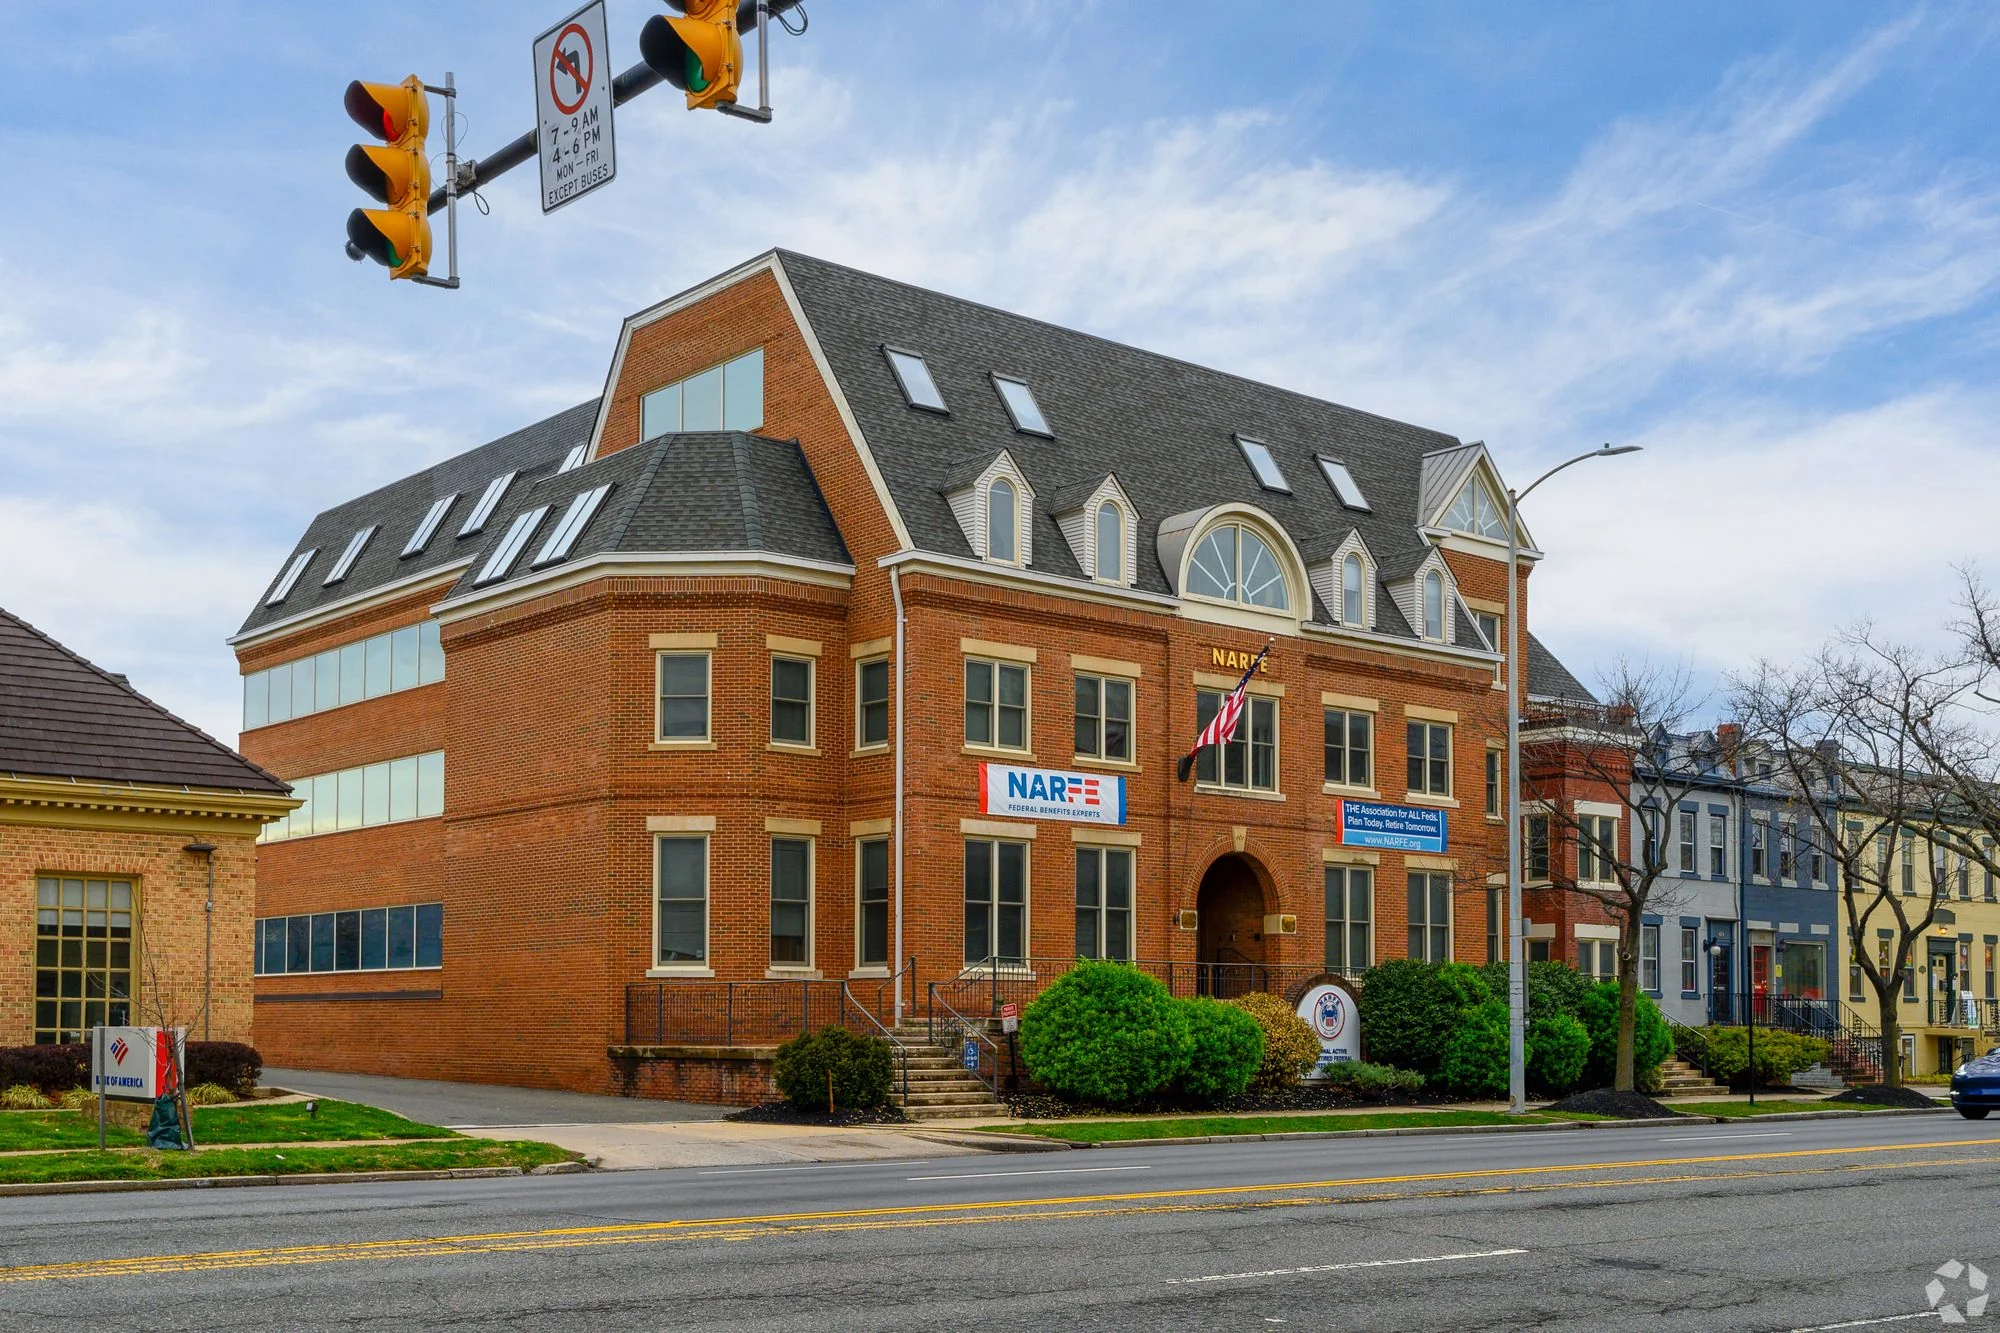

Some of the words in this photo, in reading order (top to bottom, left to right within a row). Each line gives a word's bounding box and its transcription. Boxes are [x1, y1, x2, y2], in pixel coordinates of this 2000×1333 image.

[582, 105, 599, 128] AM
[584, 125, 601, 149] PM
[548, 178, 578, 205] EXCEPT
[581, 163, 608, 189] BUSES
[1008, 771, 1100, 805] NARFE
[1008, 804, 1037, 813] FEDERAL
[1040, 806, 1070, 816] BENEFITS
[1072, 809, 1100, 818] EXPERTS
[1345, 803, 1360, 814] THE
[1361, 805, 1398, 818] Association
[1398, 808, 1408, 818] for
[1408, 810, 1420, 820] ALL
[1421, 811, 1439, 822] Feds.
[1347, 816, 1362, 826] Plan
[1363, 818, 1385, 830] Today.
[1385, 820, 1404, 830] Retire
[1405, 821, 1438, 833] Tomorrow.
[1364, 836, 1421, 850] www.NARFE.org
[110, 1075, 118, 1086] OF
[118, 1076, 143, 1088] AMERICA
